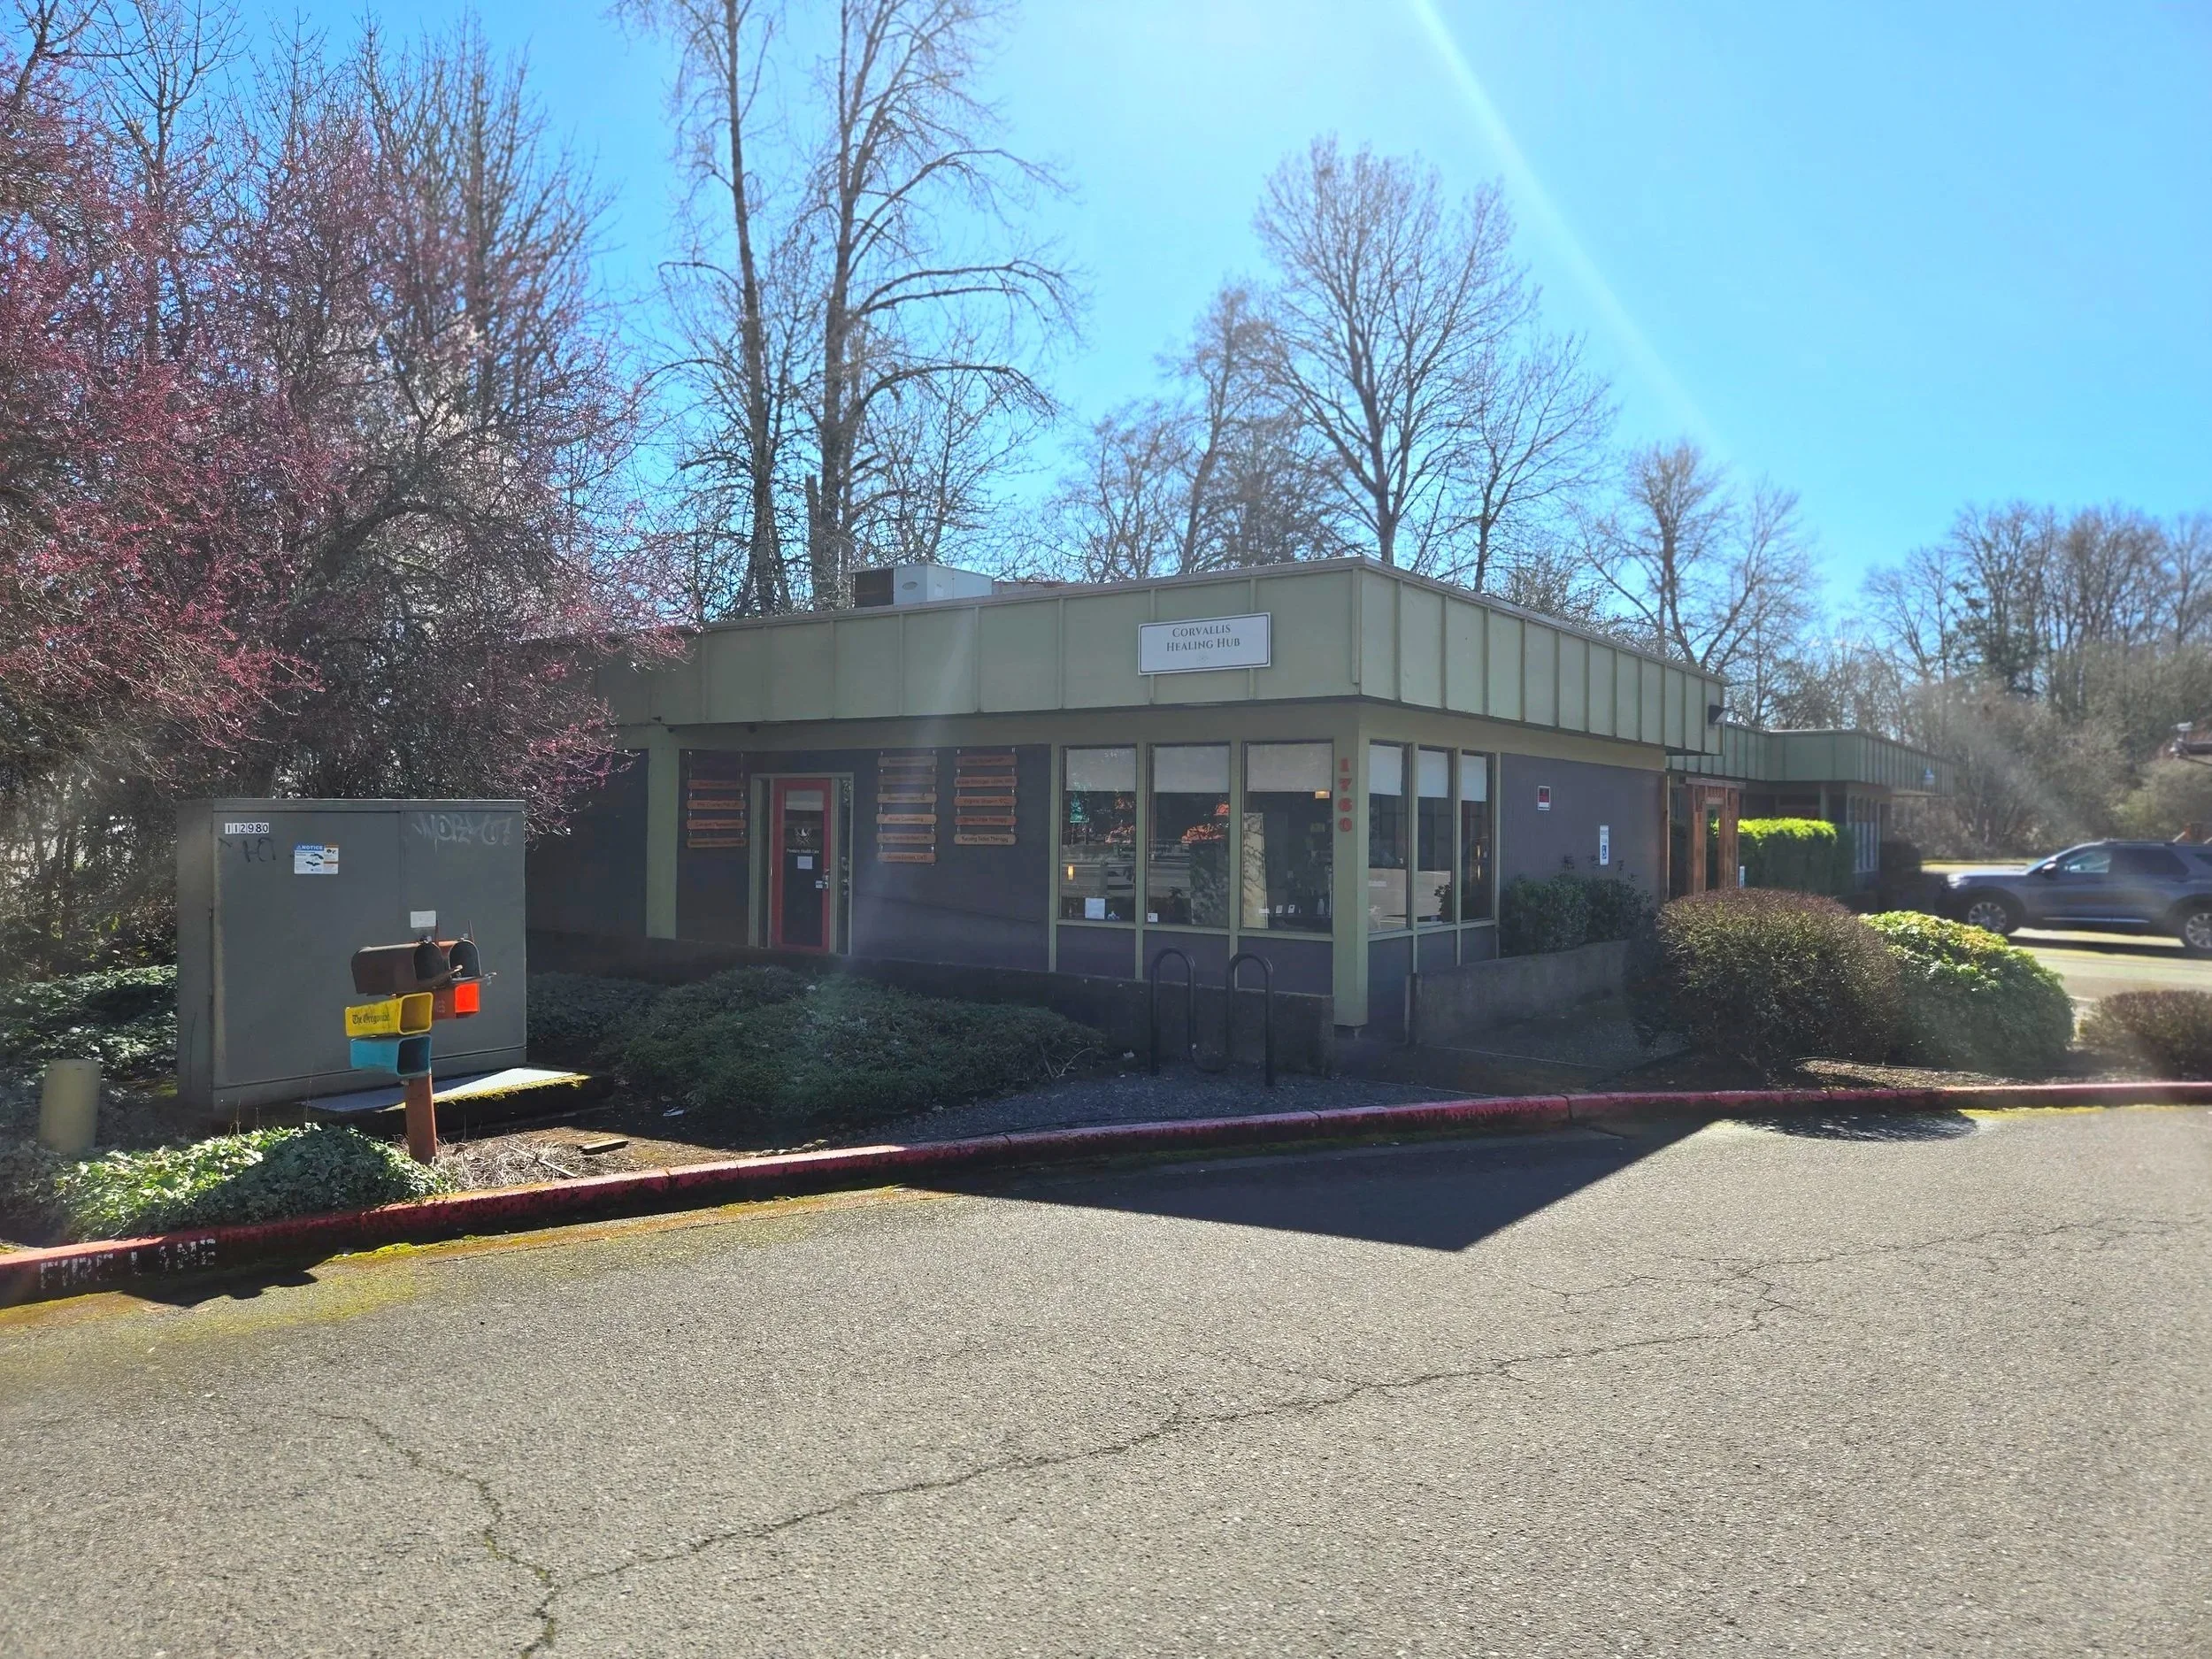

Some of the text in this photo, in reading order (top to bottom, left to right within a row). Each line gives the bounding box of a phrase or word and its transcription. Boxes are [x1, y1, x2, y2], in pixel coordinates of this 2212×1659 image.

[1171, 624, 1232, 638] CORVALLIS
[1165, 637, 1241, 653] HEALING HUB
[1338, 757, 1353, 833] 1760
[227, 823, 269, 833] 112980
[351, 1014, 363, 1025] The
